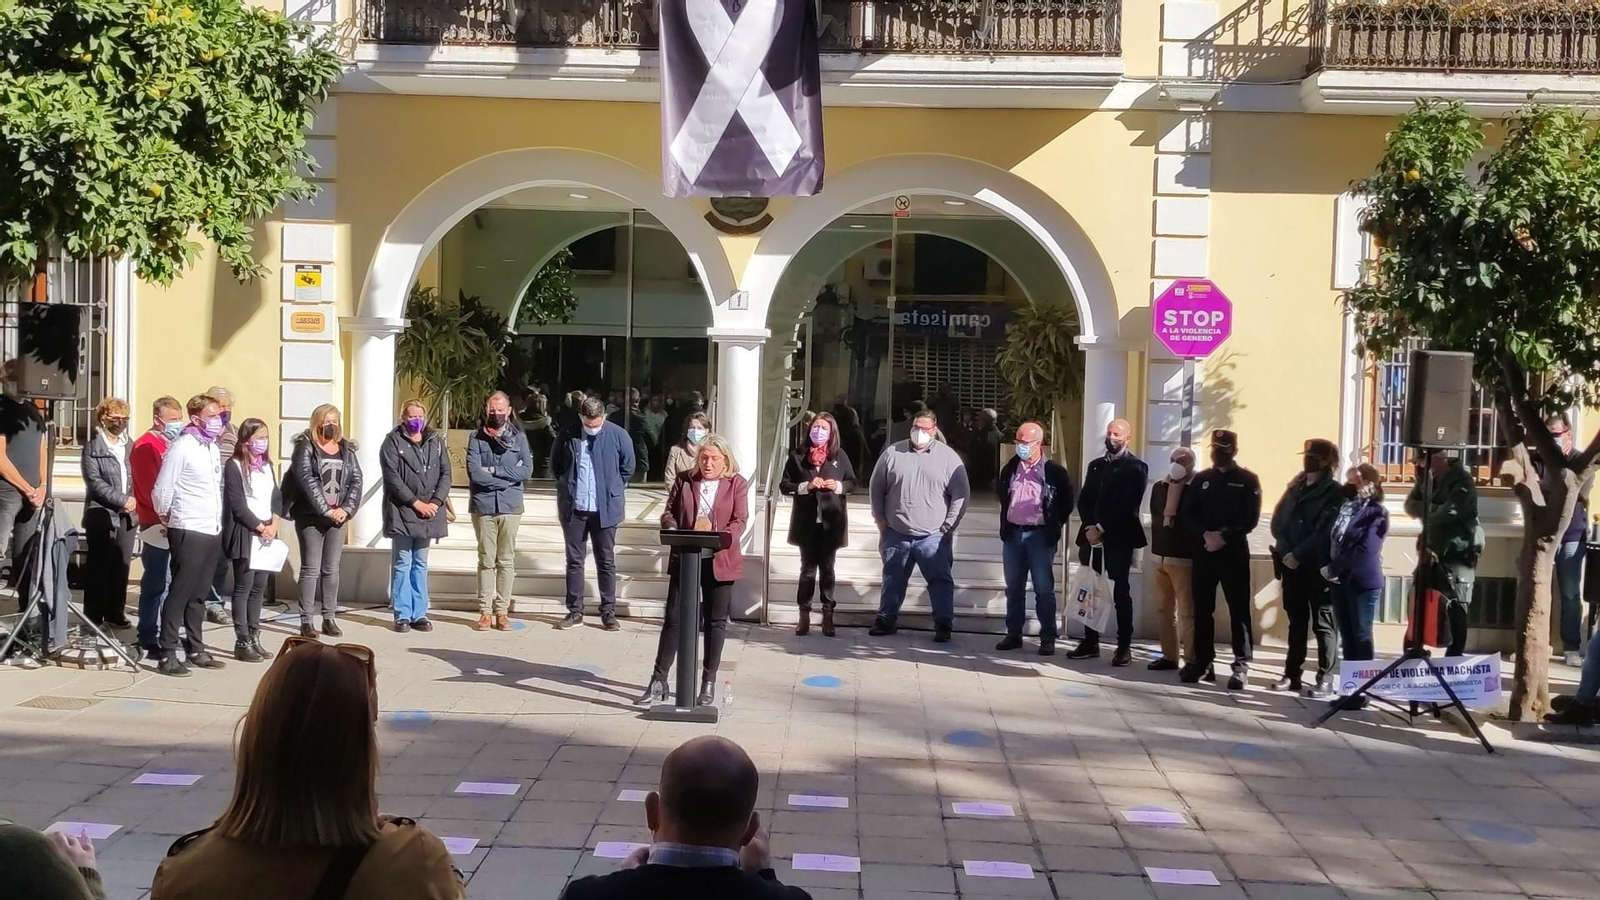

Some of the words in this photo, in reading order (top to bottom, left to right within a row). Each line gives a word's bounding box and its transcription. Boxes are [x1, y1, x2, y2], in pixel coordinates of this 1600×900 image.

[738, 294, 742, 306] 1
[1163, 310, 1224, 326] STOP
[1352, 668, 1389, 679] #HART
[1390, 668, 1400, 679] DE
[1447, 665, 1491, 676] MACHISTA
[1371, 682, 1391, 691] AVOR
[1392, 682, 1401, 690] DE
[1449, 679, 1482, 688] EMINISTA
